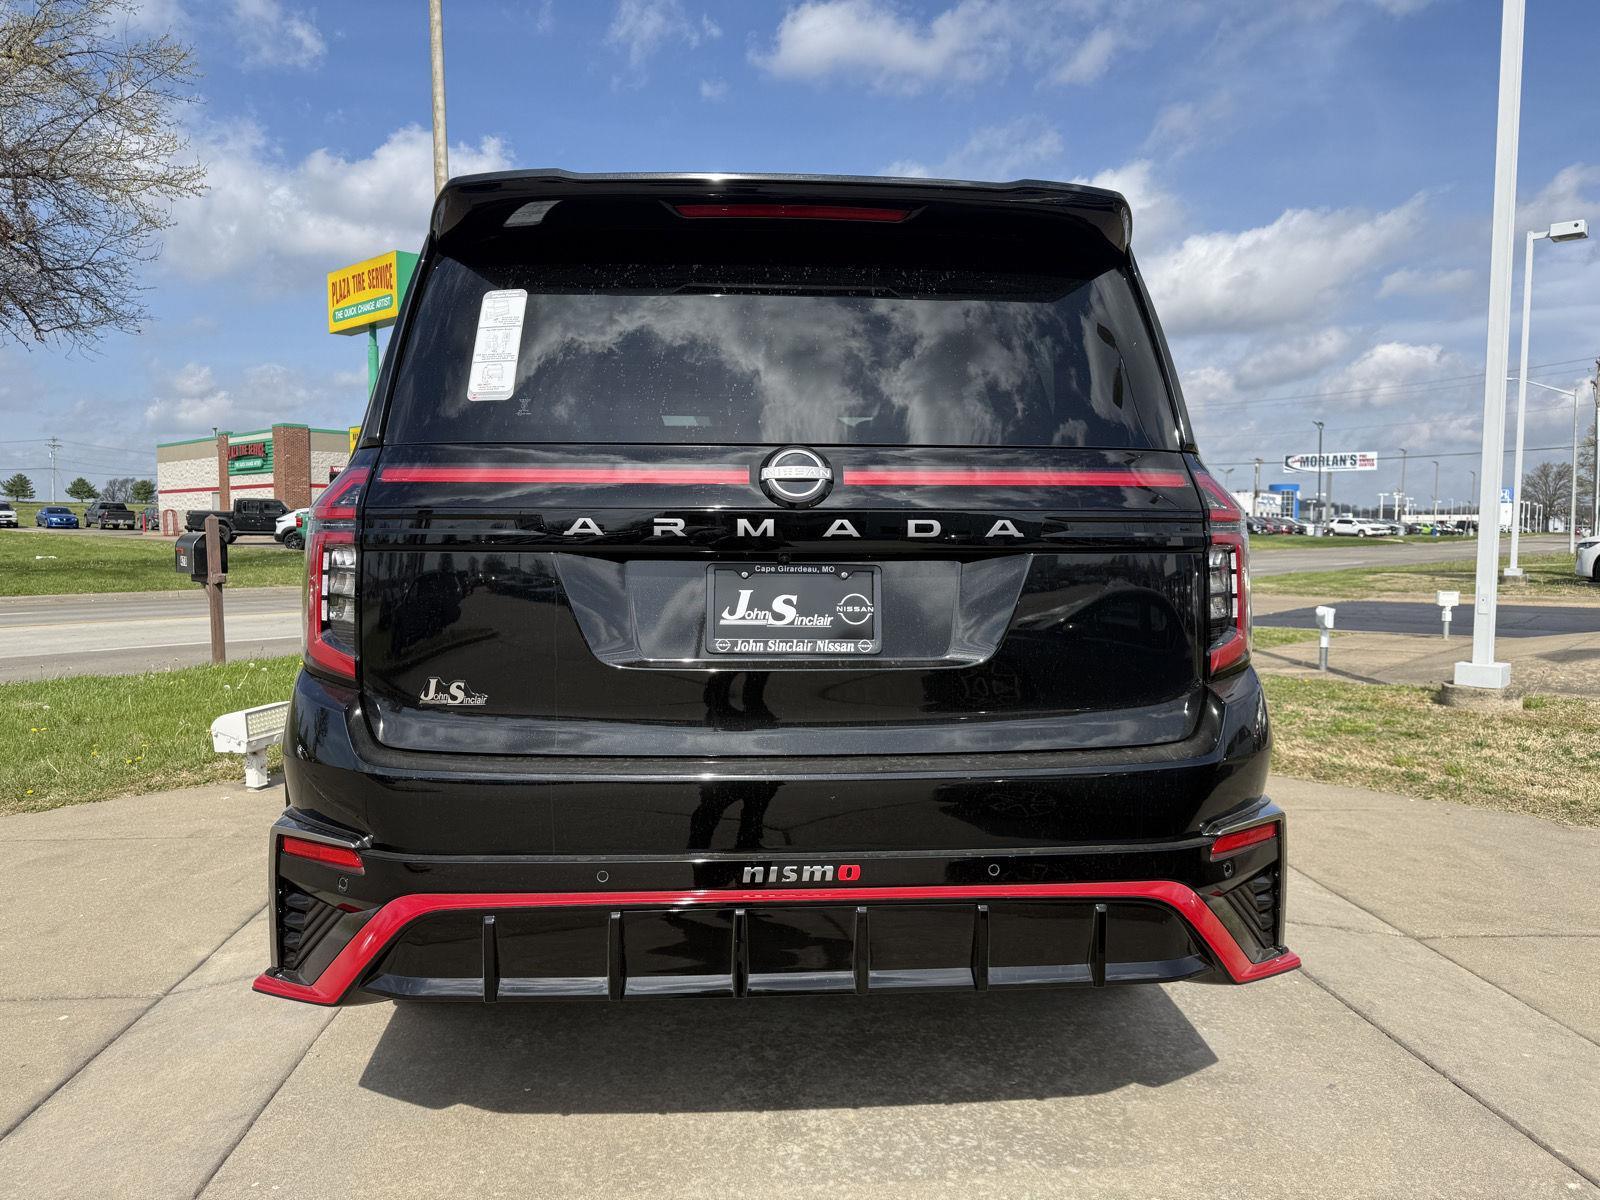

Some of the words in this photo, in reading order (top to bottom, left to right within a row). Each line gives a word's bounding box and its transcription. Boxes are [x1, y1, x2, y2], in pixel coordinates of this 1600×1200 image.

[331, 276, 350, 307] PLAZA
[352, 272, 365, 294] TIRE
[368, 262, 393, 290] SERVICE
[335, 311, 344, 320] THE
[343, 307, 357, 317] QUICK
[357, 301, 375, 313] CHANGE
[376, 296, 391, 308] ARTIST
[1300, 454, 1357, 468] MORLAN'S
[762, 467, 831, 479] NISSAN
[564, 517, 1025, 539] ARMADA
[754, 565, 776, 573] Cape
[778, 565, 820, 573] Girardeau,
[720, 589, 769, 621] John
[767, 594, 834, 626] Sinclair
[836, 605, 874, 613] NISSAN
[734, 640, 764, 652] John
[767, 640, 813, 652] Sinclair
[815, 641, 855, 652] Nissan
[420, 678, 448, 701] John
[447, 681, 487, 704] Sinclair
[742, 864, 861, 884] nismo
